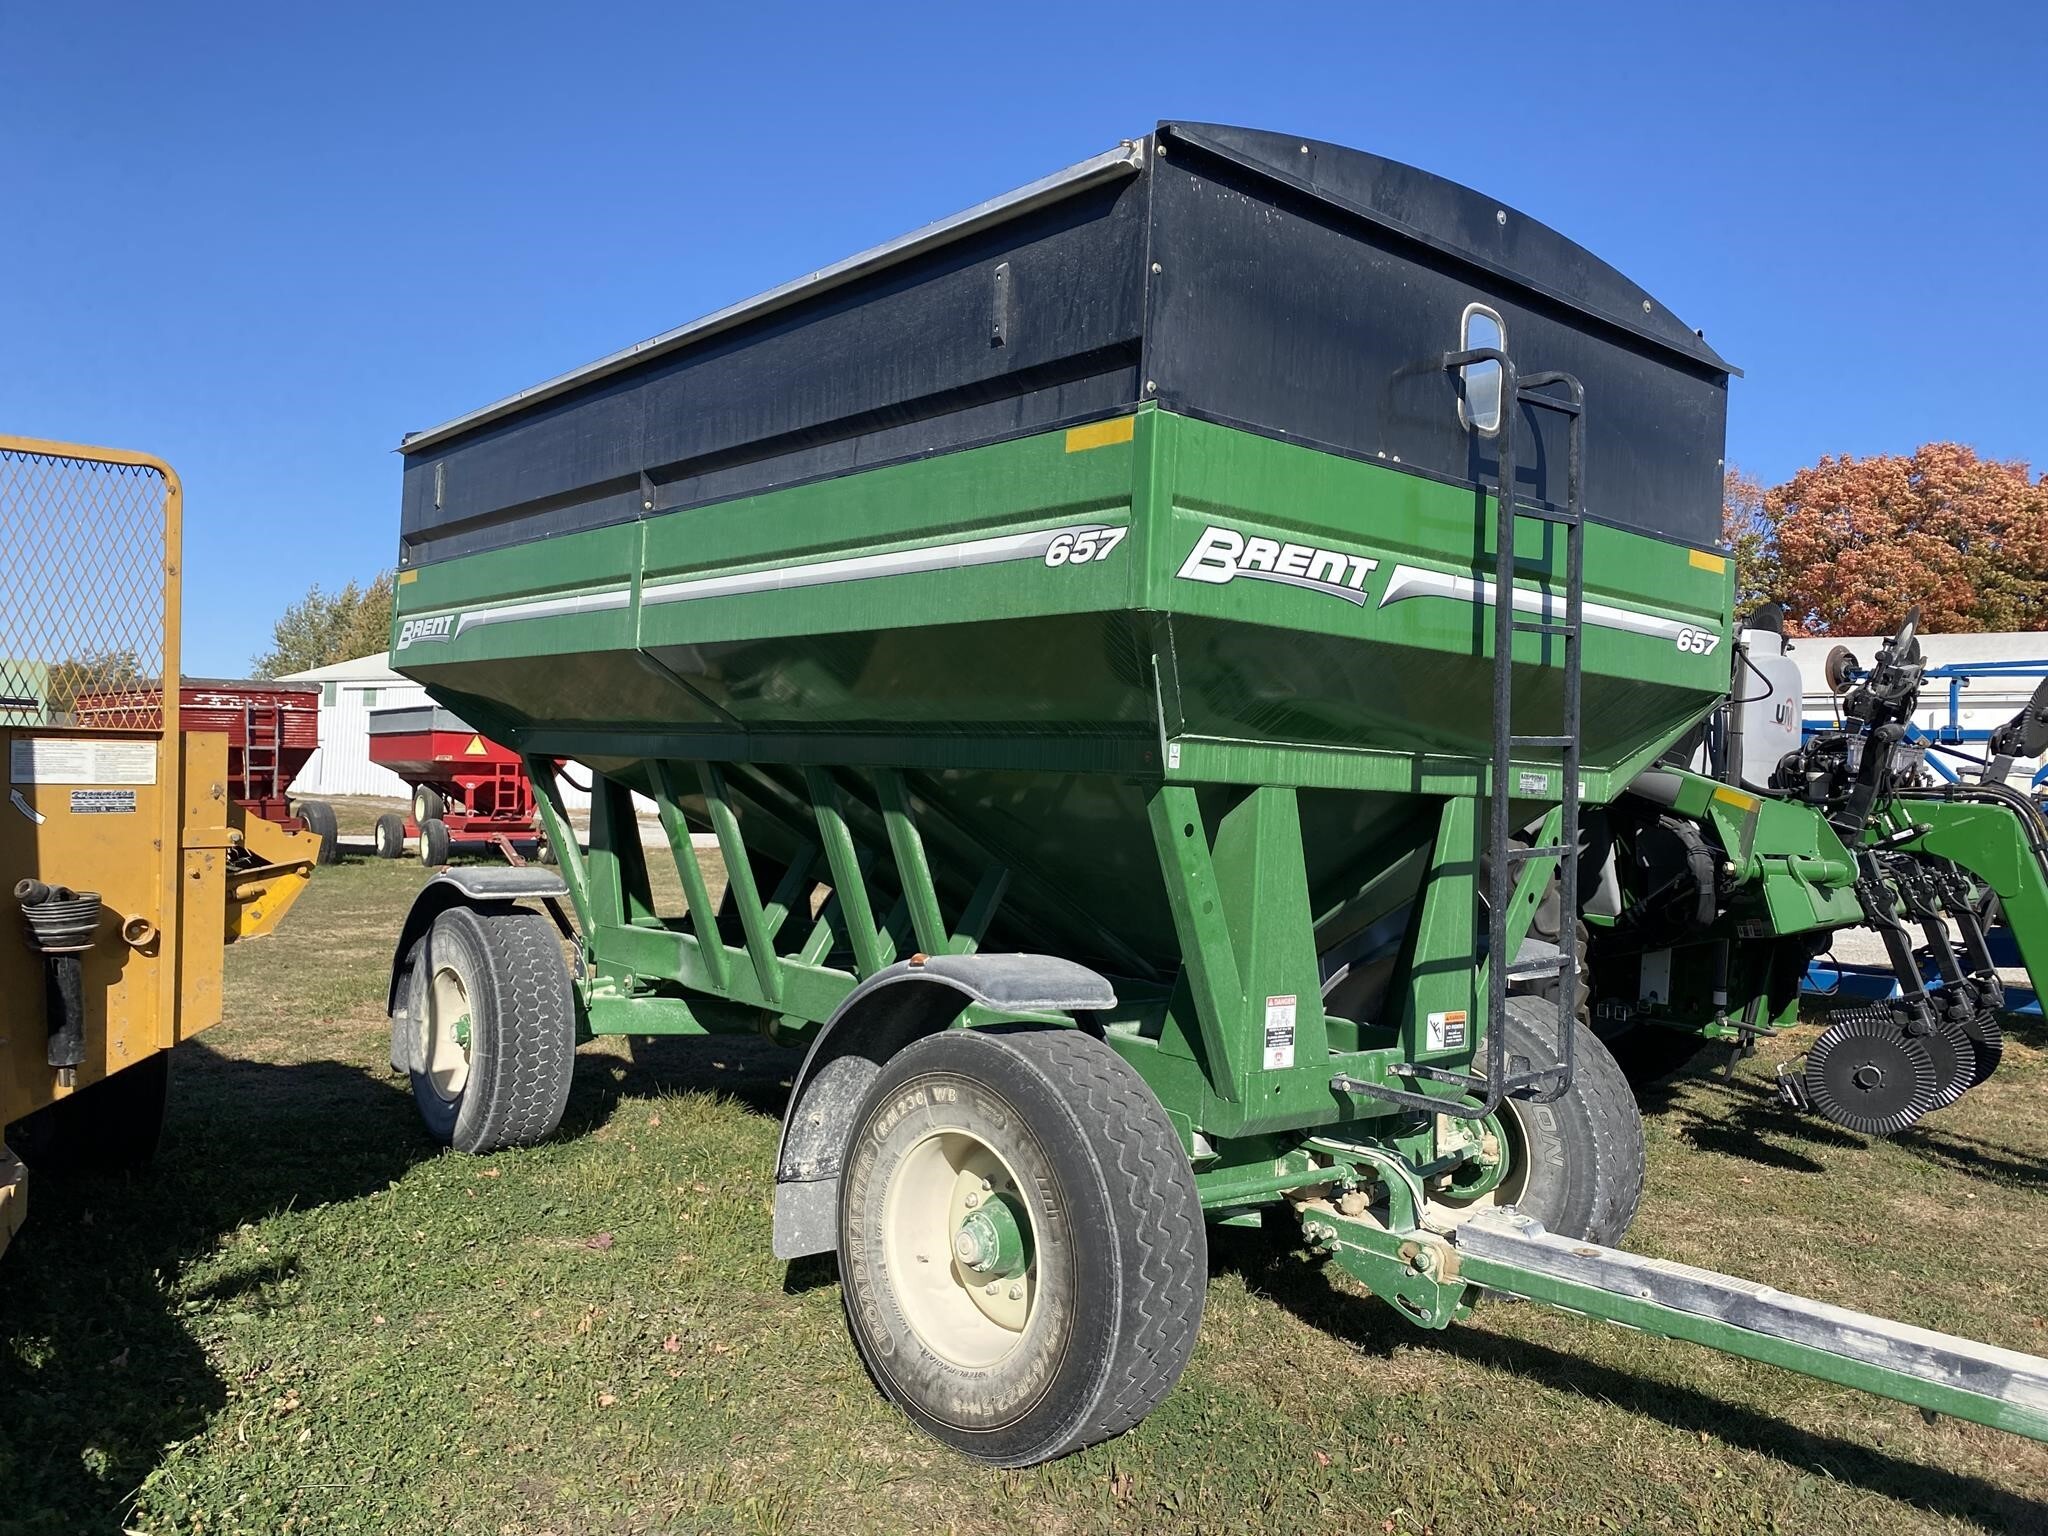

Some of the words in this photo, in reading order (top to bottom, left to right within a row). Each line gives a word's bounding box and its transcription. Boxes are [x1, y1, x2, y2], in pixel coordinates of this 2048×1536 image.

[1045, 525, 1129, 568] 657
[1175, 524, 1380, 593] BRENT
[396, 614, 455, 650] BRENT
[1677, 628, 1720, 656] 657
[932, 1087, 957, 1103] WB
[850, 1150, 888, 1343] ROADMASTER
